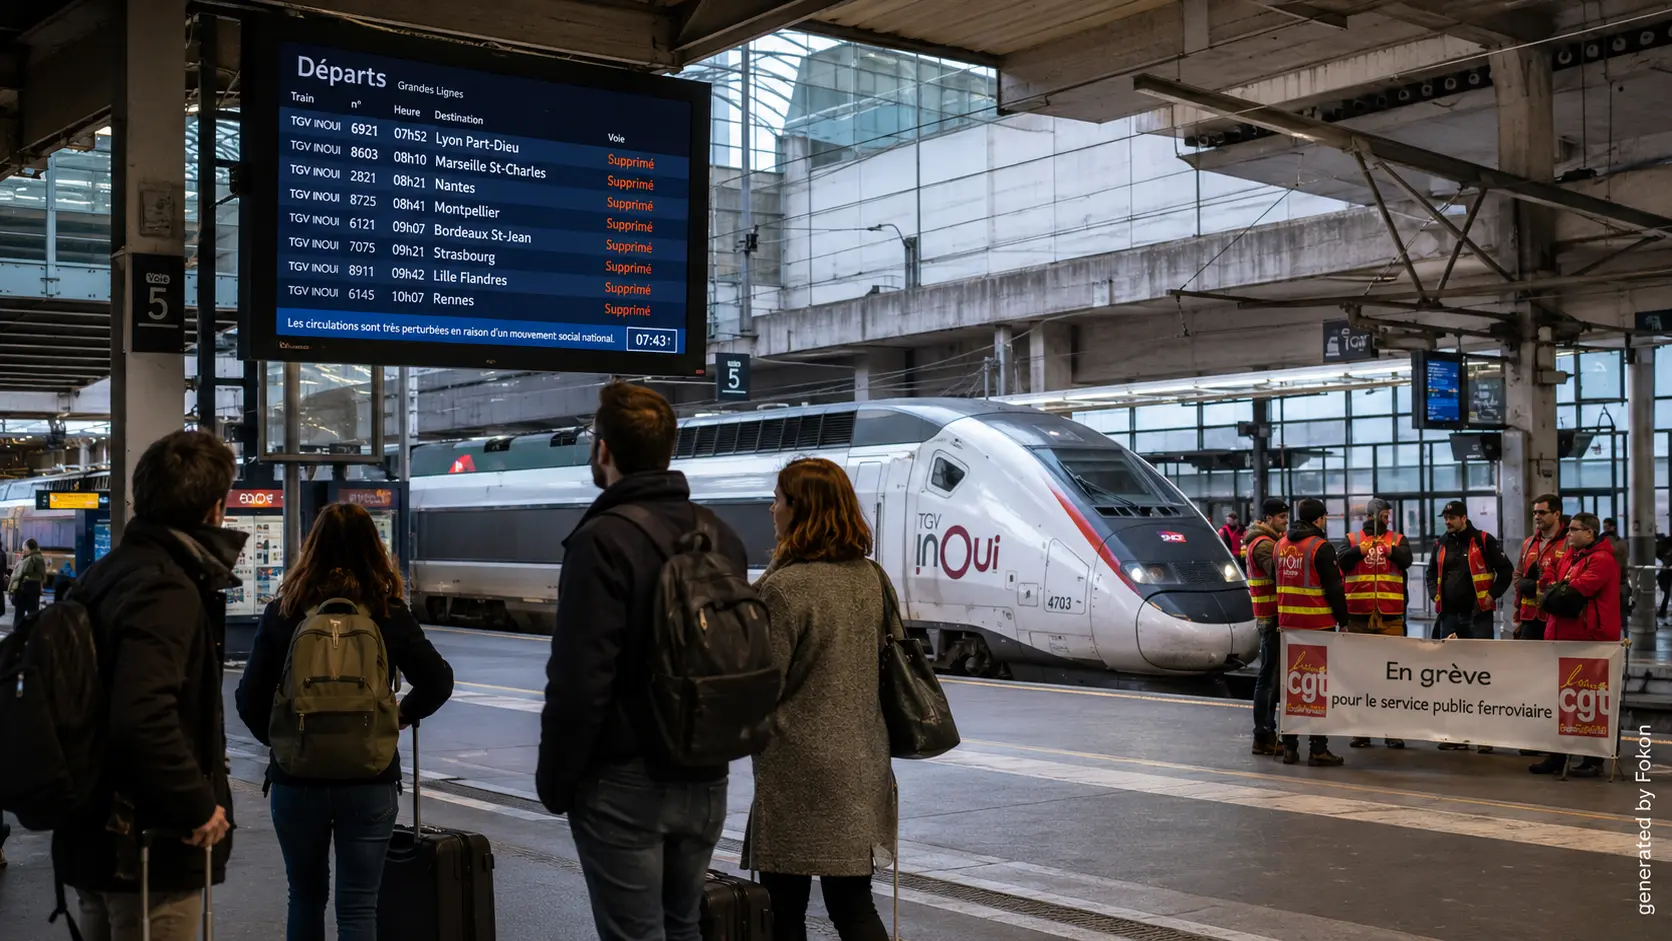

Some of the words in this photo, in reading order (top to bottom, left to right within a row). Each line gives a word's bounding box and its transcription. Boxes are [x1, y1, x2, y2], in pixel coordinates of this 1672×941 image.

[298, 56, 386, 87] Départs
[398, 81, 434, 94] Grandes
[437, 87, 463, 98] Lignes
[291, 91, 314, 103] Train
[395, 105, 420, 117] Heure
[435, 110, 483, 124] Destination
[291, 116, 311, 126] TGV
[351, 123, 377, 136] 6921
[394, 128, 426, 142] 07h52
[436, 132, 462, 147] Lyon
[466, 136, 518, 153] Part-Dieu
[608, 154, 654, 169] Supprimé
[291, 140, 311, 150] TGV
[351, 147, 378, 159] 8603
[394, 151, 426, 165] 08h10
[436, 155, 486, 172] Marseille
[490, 162, 546, 178] St-Charles
[608, 175, 654, 190] Supprimé
[290, 164, 311, 174] TGV
[351, 170, 375, 183] 2821
[394, 175, 425, 188] 08h21
[436, 178, 475, 193] Nantes
[607, 197, 653, 211] Supprimé
[290, 189, 310, 199] TGV
[350, 194, 376, 206] 8725
[393, 198, 424, 211] 08h41
[435, 201, 500, 218] Montpellier
[607, 218, 653, 232] Supprimé
[289, 213, 310, 222] TGV
[350, 218, 374, 229] 6121
[393, 221, 425, 234] 09h07
[435, 224, 488, 239] Bordeaux
[491, 229, 531, 243] St-Jean
[606, 239, 652, 254] Supprimé
[289, 237, 309, 247] TGV
[350, 241, 375, 253] 7075
[393, 244, 423, 257] 09h21
[434, 247, 495, 265] Strasbourg
[606, 261, 652, 275] Supprimé
[289, 261, 309, 271] TGV
[349, 265, 373, 276] 8911
[392, 268, 424, 280] 09h42
[434, 270, 457, 282] Lille
[461, 272, 507, 285] Flandres
[605, 282, 651, 295] Supprimé
[148, 287, 168, 320] 5
[288, 286, 309, 295] TGV
[349, 289, 374, 300] 6145
[393, 291, 424, 302] 10h07
[434, 293, 474, 306] Rennes
[605, 303, 650, 317] Supprimé
[288, 318, 303, 328] Les
[306, 319, 359, 330] circulations
[402, 325, 449, 335] perturbées
[510, 331, 557, 340] mouvement
[559, 332, 580, 341] social
[582, 333, 615, 343] national.
[728, 368, 740, 389] 5
[918, 513, 941, 530] TGV
[1048, 596, 1071, 610] 4703
[1288, 671, 1328, 703] cgt
[1387, 661, 1411, 680] En
[1421, 663, 1491, 687] grève
[1332, 696, 1362, 709] pour
[1366, 693, 1376, 707] le
[1381, 697, 1428, 710] service
[1433, 698, 1473, 716] public
[1478, 700, 1552, 718] ferroviaire
[1560, 688, 1611, 722] cgt
